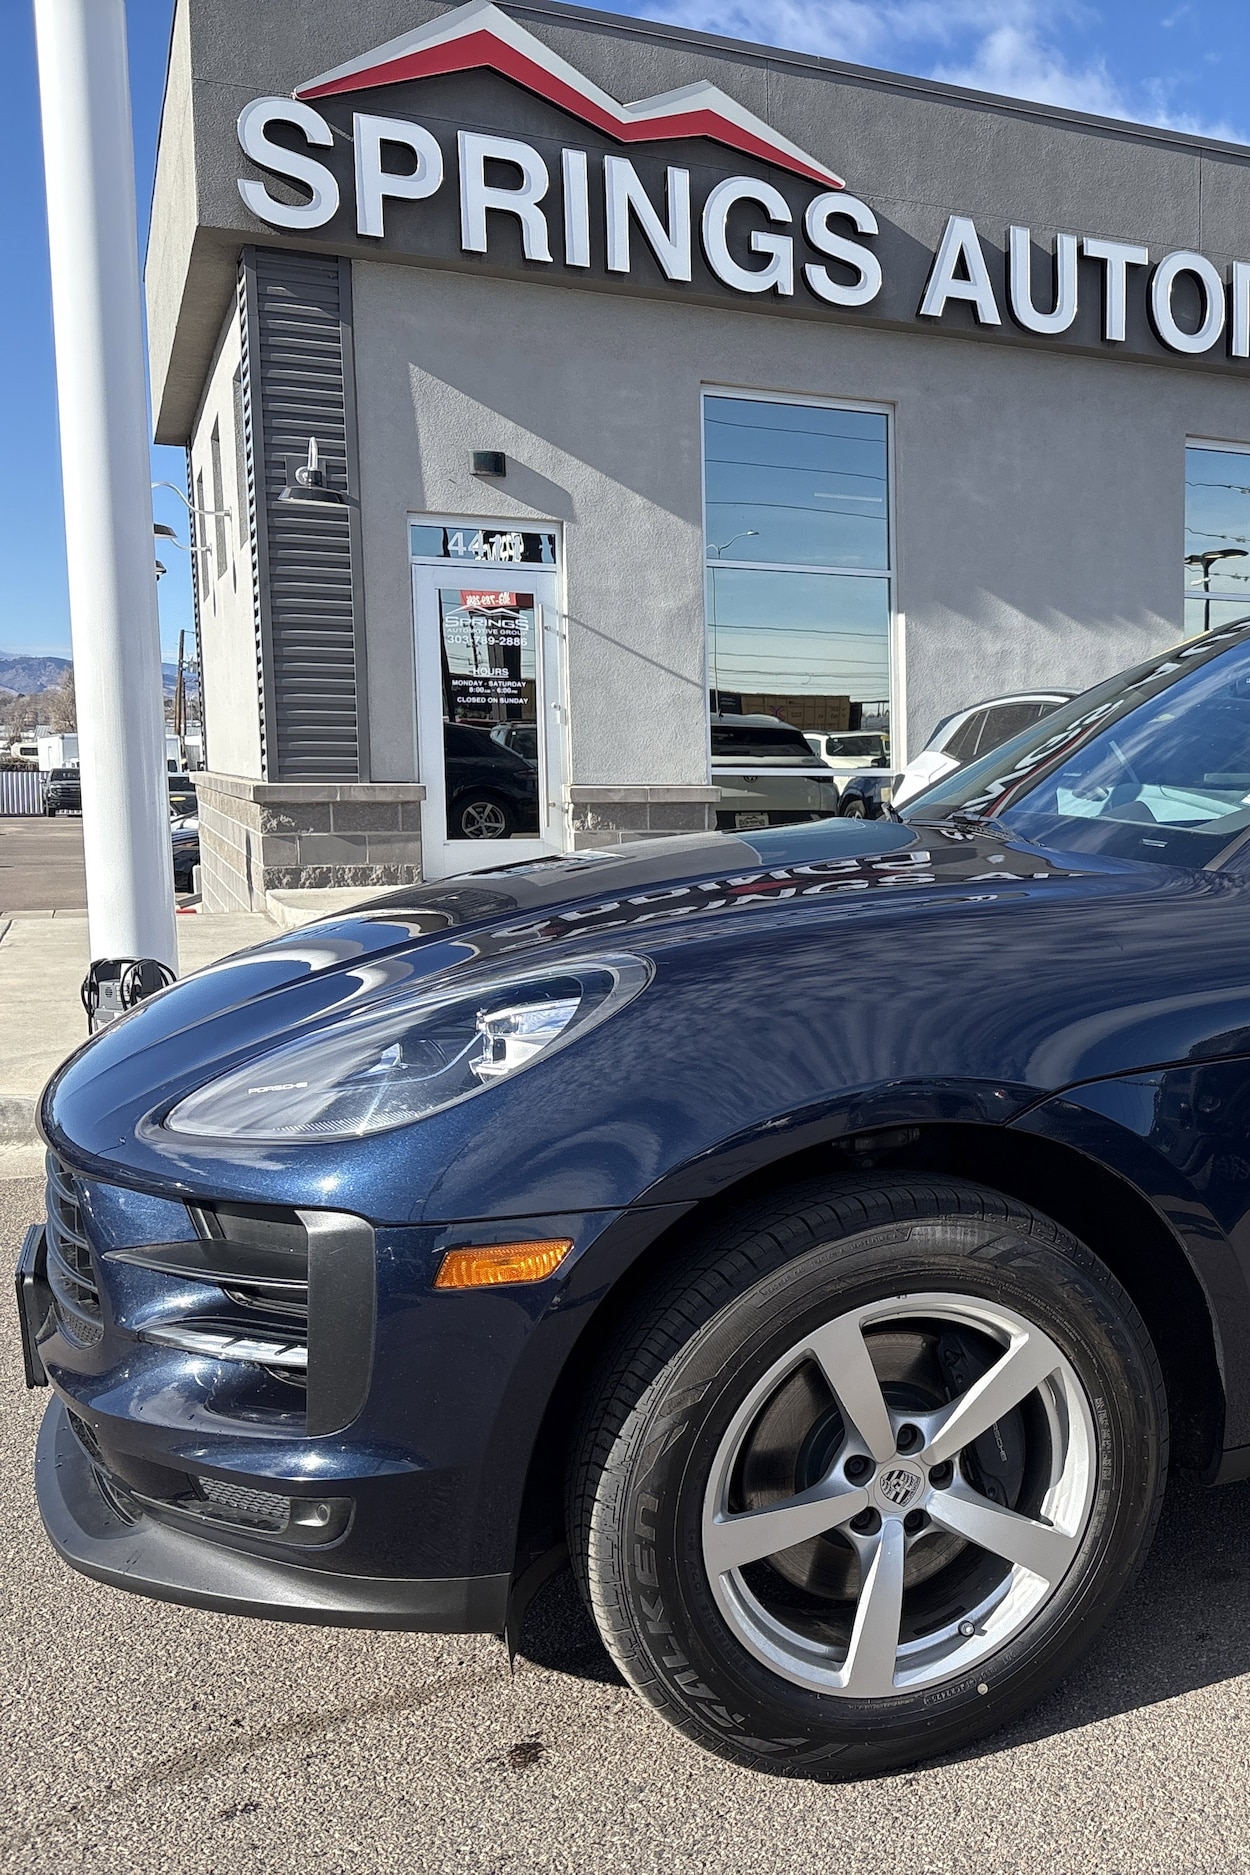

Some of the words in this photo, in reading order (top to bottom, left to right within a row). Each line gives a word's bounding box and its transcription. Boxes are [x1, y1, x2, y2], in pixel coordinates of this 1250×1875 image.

[237, 97, 882, 306] SPRINGS
[445, 616, 529, 631] SPRINGS
[447, 635, 528, 646] 303-789-2886
[473, 668, 509, 676] HOURS
[248, 1082, 308, 1095] PORSCHE
[634, 1490, 746, 1732] FALKEN
